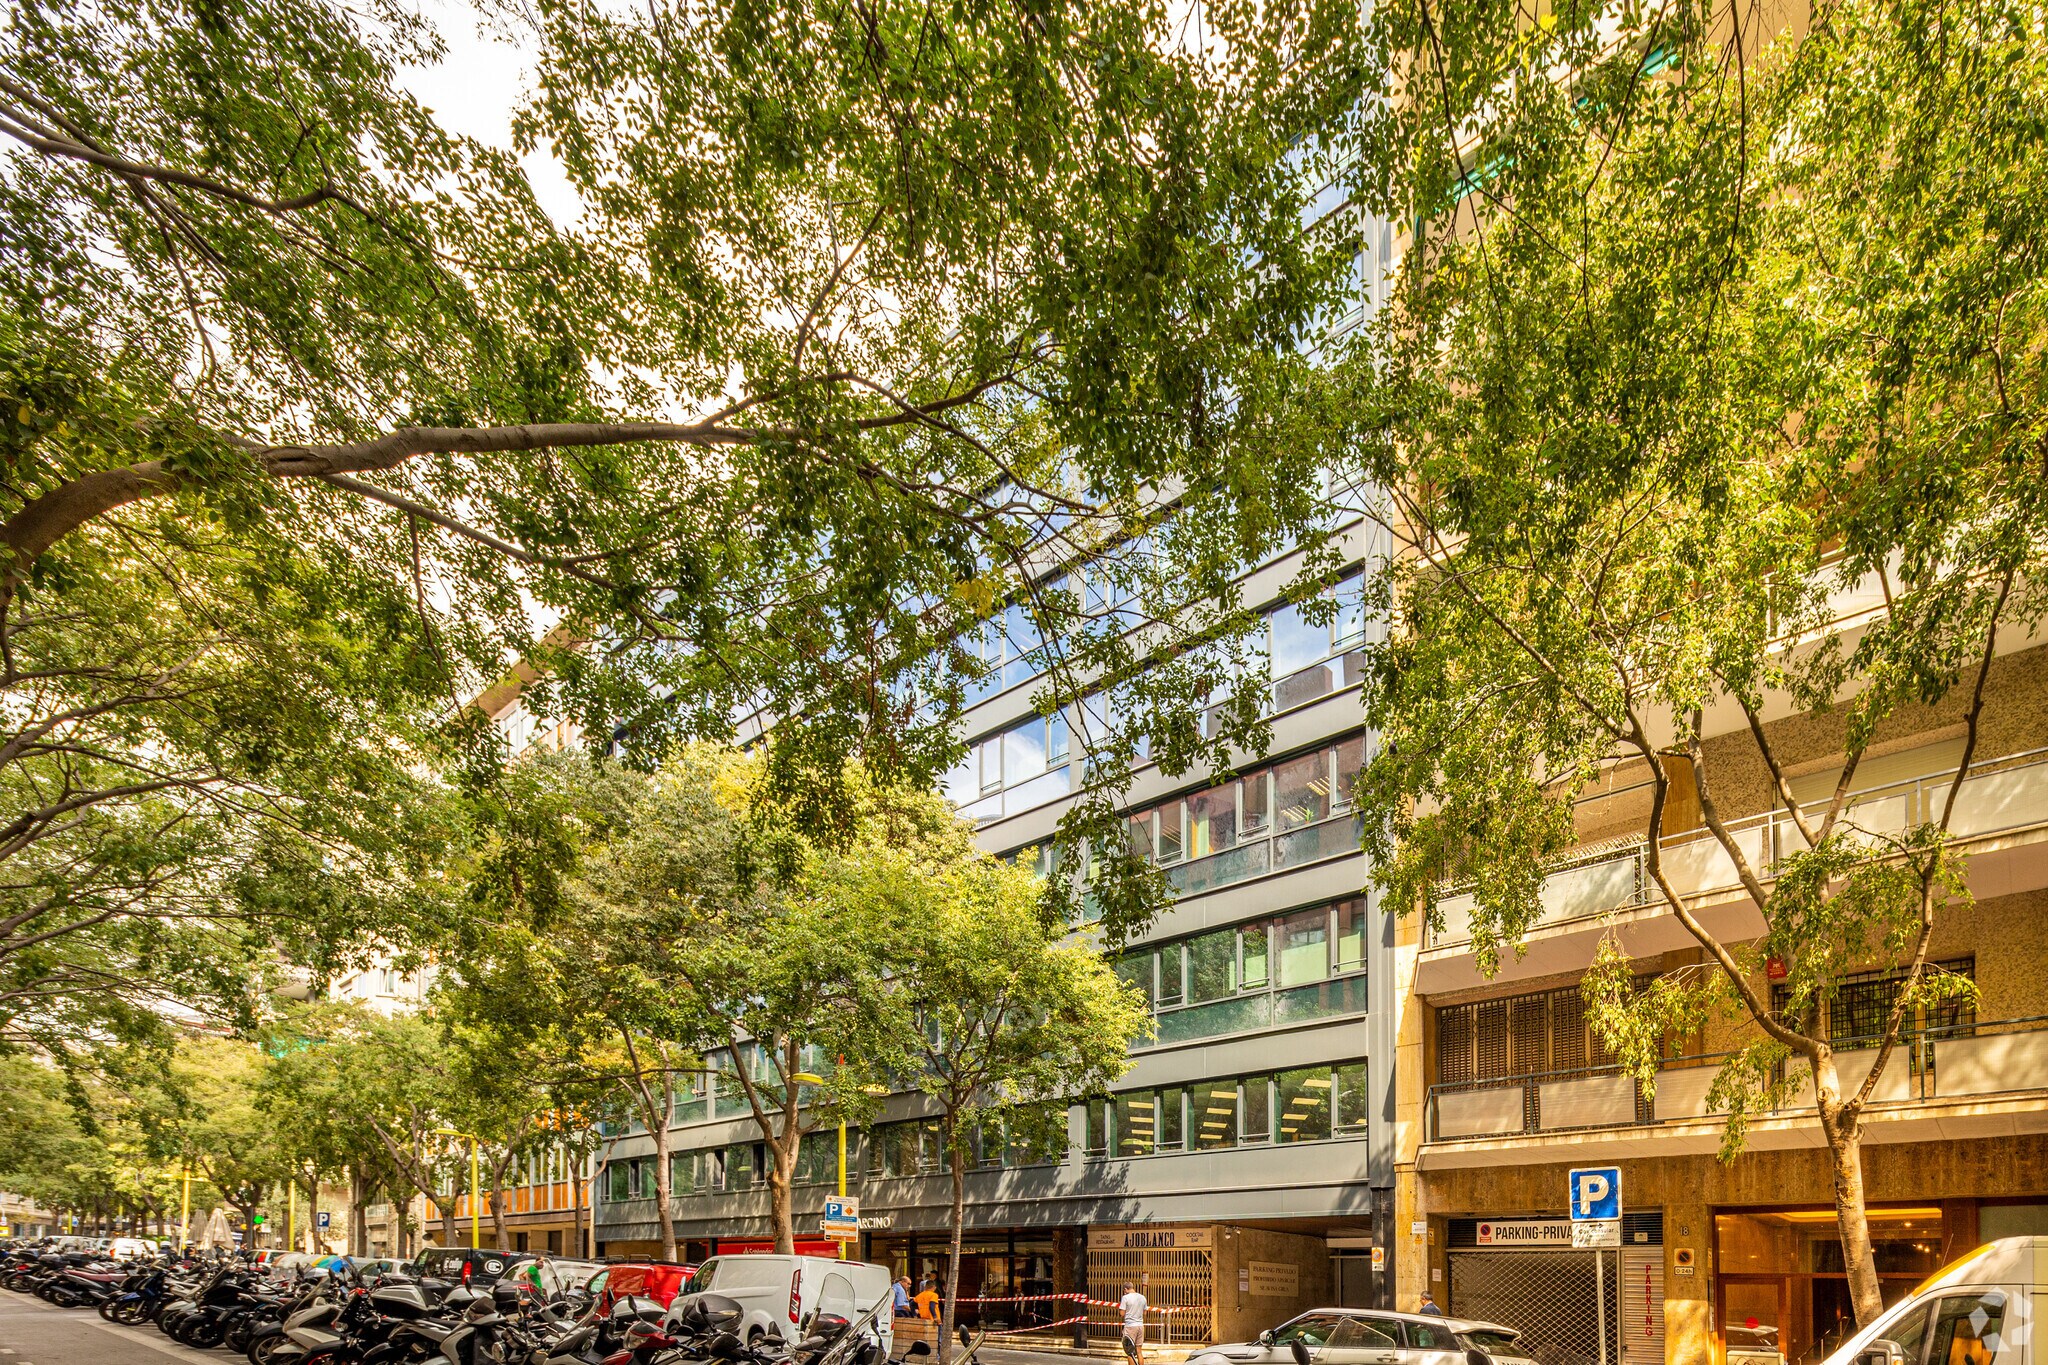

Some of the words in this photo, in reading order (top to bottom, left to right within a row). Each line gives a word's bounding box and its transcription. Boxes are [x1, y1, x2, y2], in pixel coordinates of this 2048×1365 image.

[1579, 1175, 1609, 1215] P
[829, 1204, 839, 1215] P
[319, 1213, 329, 1226] P
[1680, 1226, 1689, 1236] 18
[1124, 1231, 1175, 1248] AJOBLANCO
[1645, 1264, 1653, 1337] PARKING
